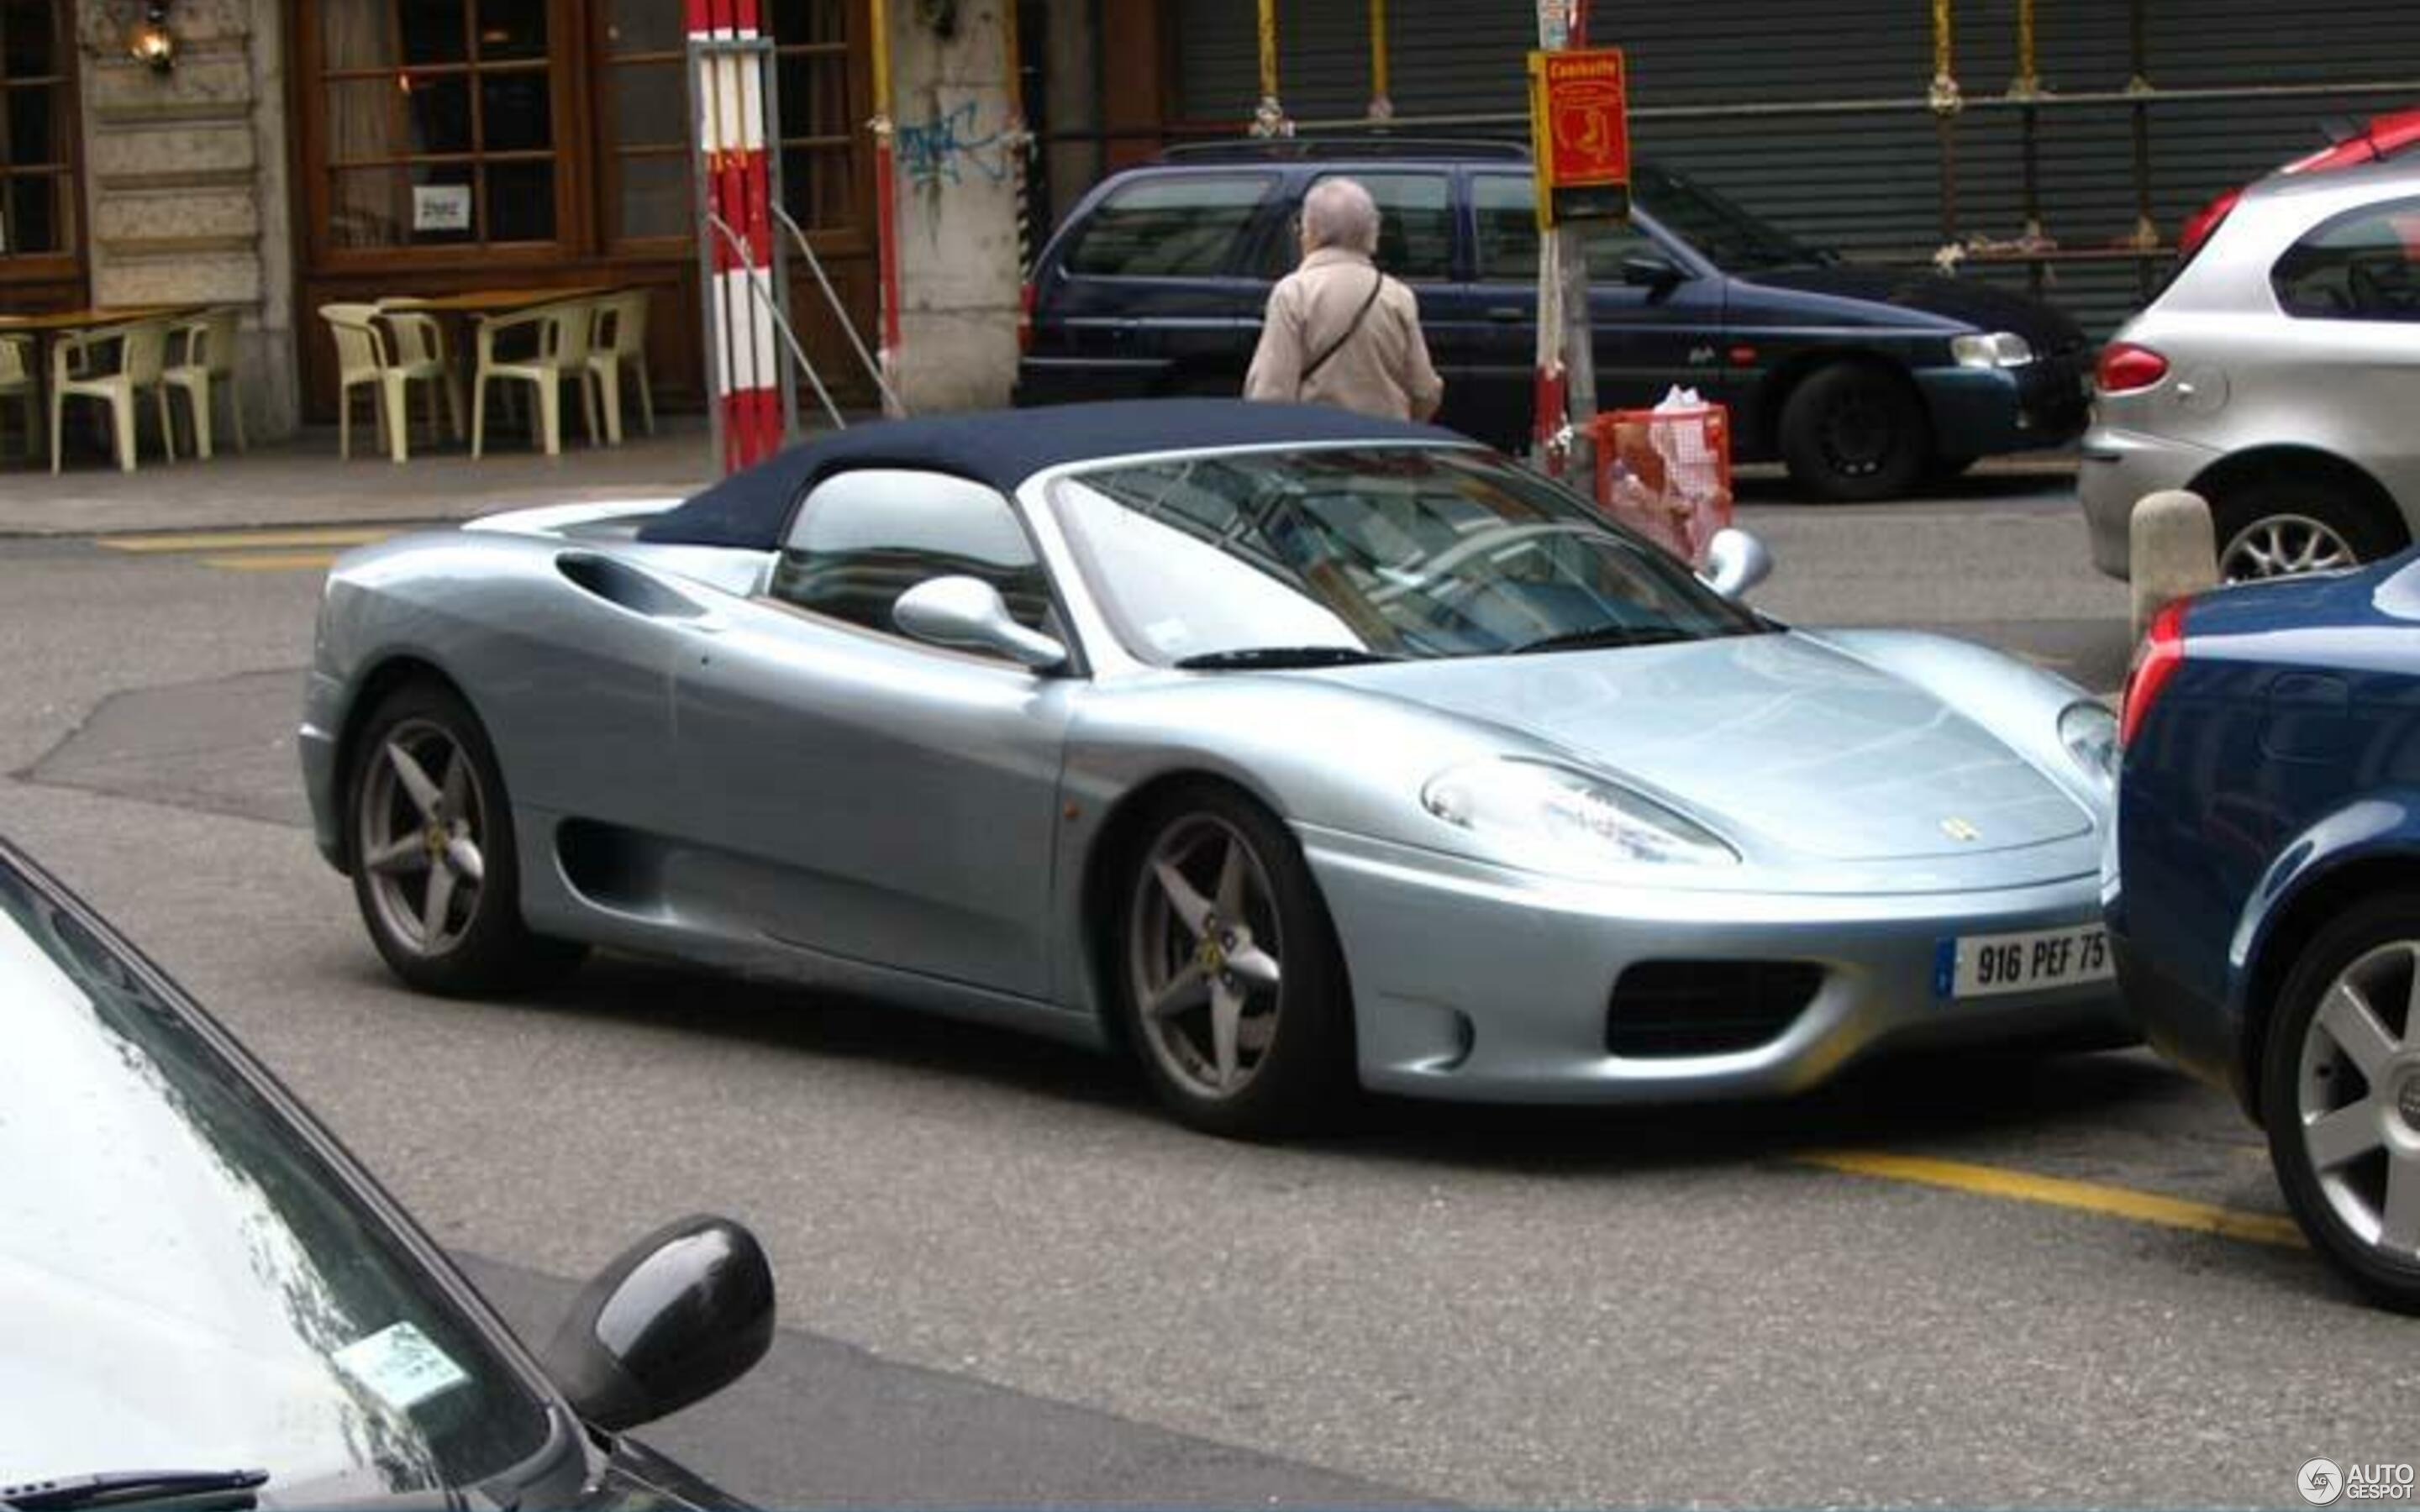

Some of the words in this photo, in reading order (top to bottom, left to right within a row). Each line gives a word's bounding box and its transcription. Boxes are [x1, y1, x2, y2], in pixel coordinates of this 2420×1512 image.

[1977, 943, 2022, 984] 916
[2031, 935, 2073, 979] PEF
[2080, 931, 2105, 970] 75
